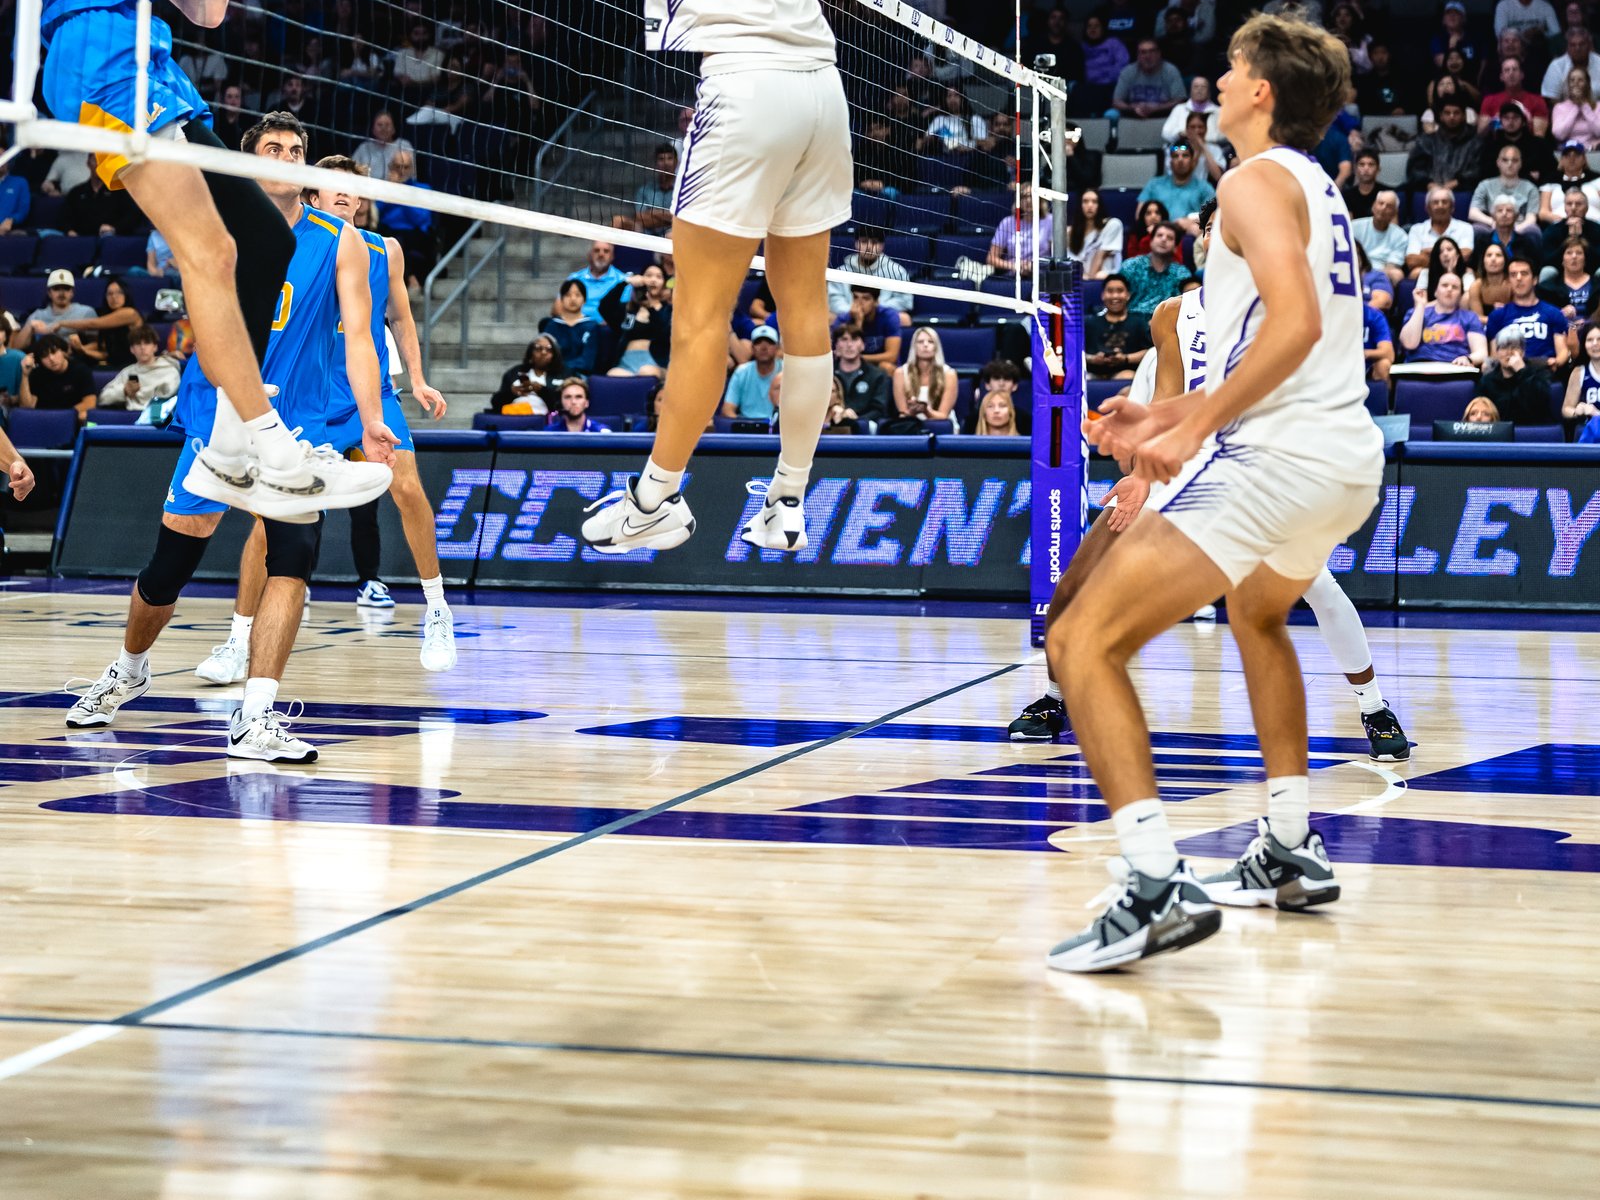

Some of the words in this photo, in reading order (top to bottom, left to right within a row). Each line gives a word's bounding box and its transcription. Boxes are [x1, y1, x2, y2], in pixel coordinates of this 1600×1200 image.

[1329, 213, 1357, 298] 9
[724, 476, 1113, 567] MEN'
[1048, 488, 1062, 531] sports
[1048, 532, 1062, 584] imports
